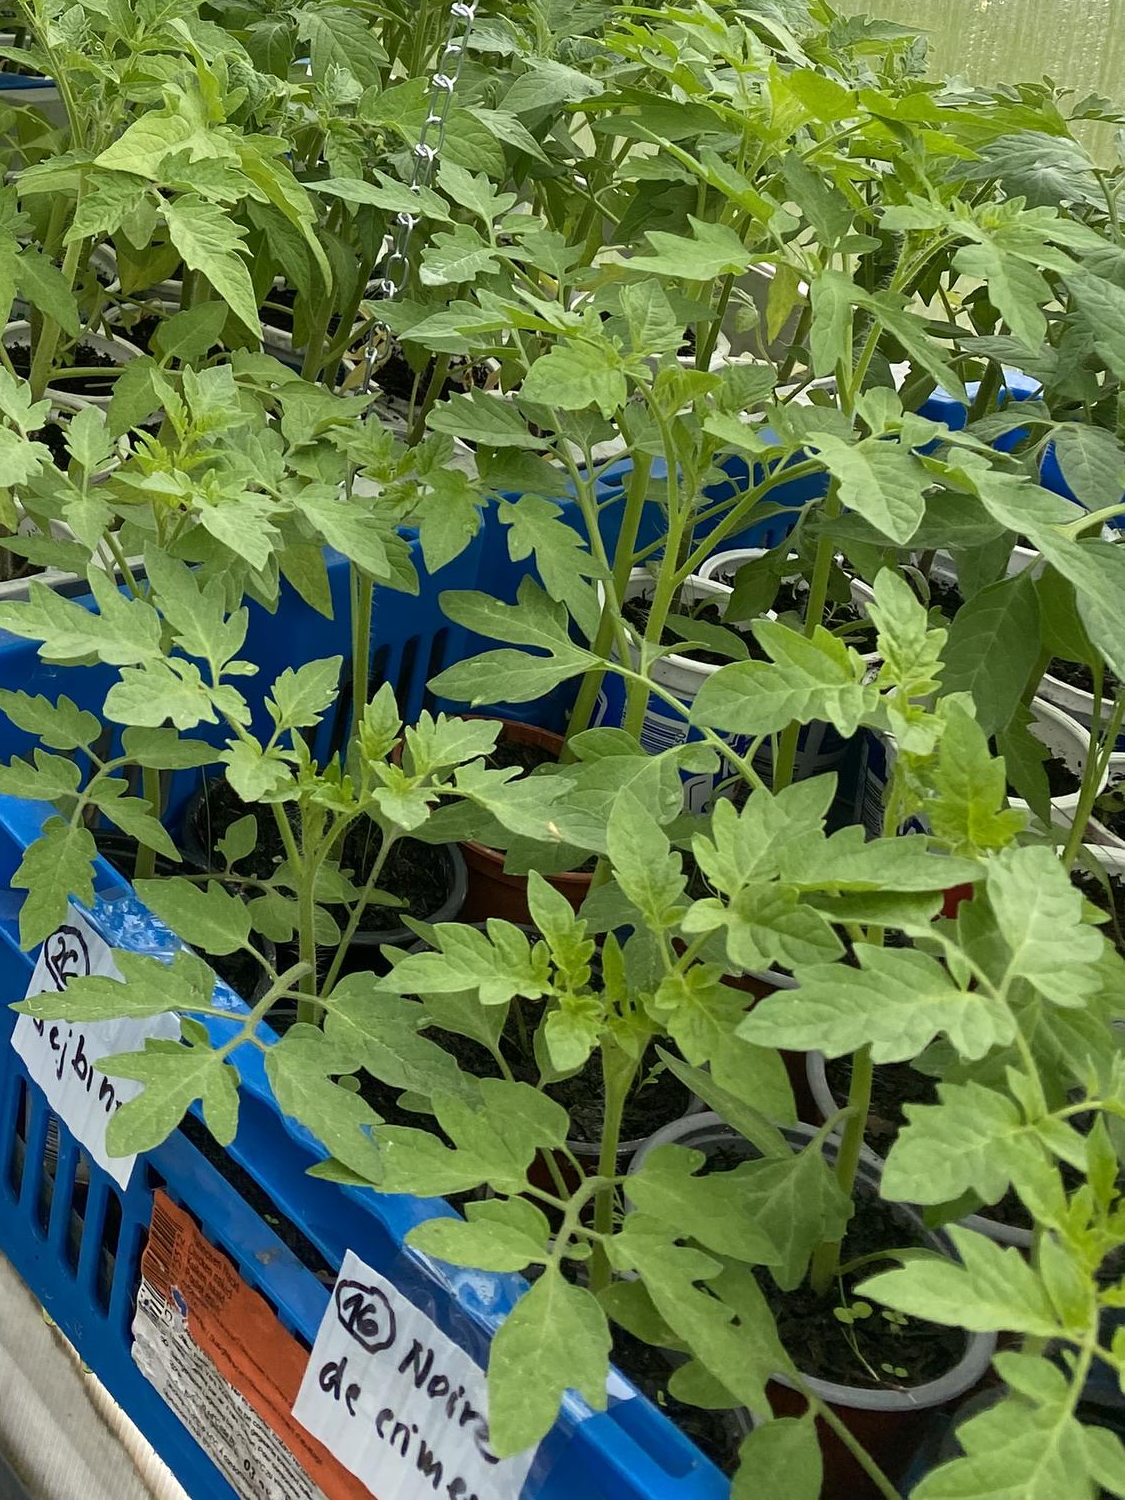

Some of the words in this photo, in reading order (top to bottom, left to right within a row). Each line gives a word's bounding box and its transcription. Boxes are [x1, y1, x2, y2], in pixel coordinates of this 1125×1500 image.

[33, 990, 123, 1112] ejbin
[319, 1356, 362, 1417] de
[375, 1408, 479, 1500] crime
